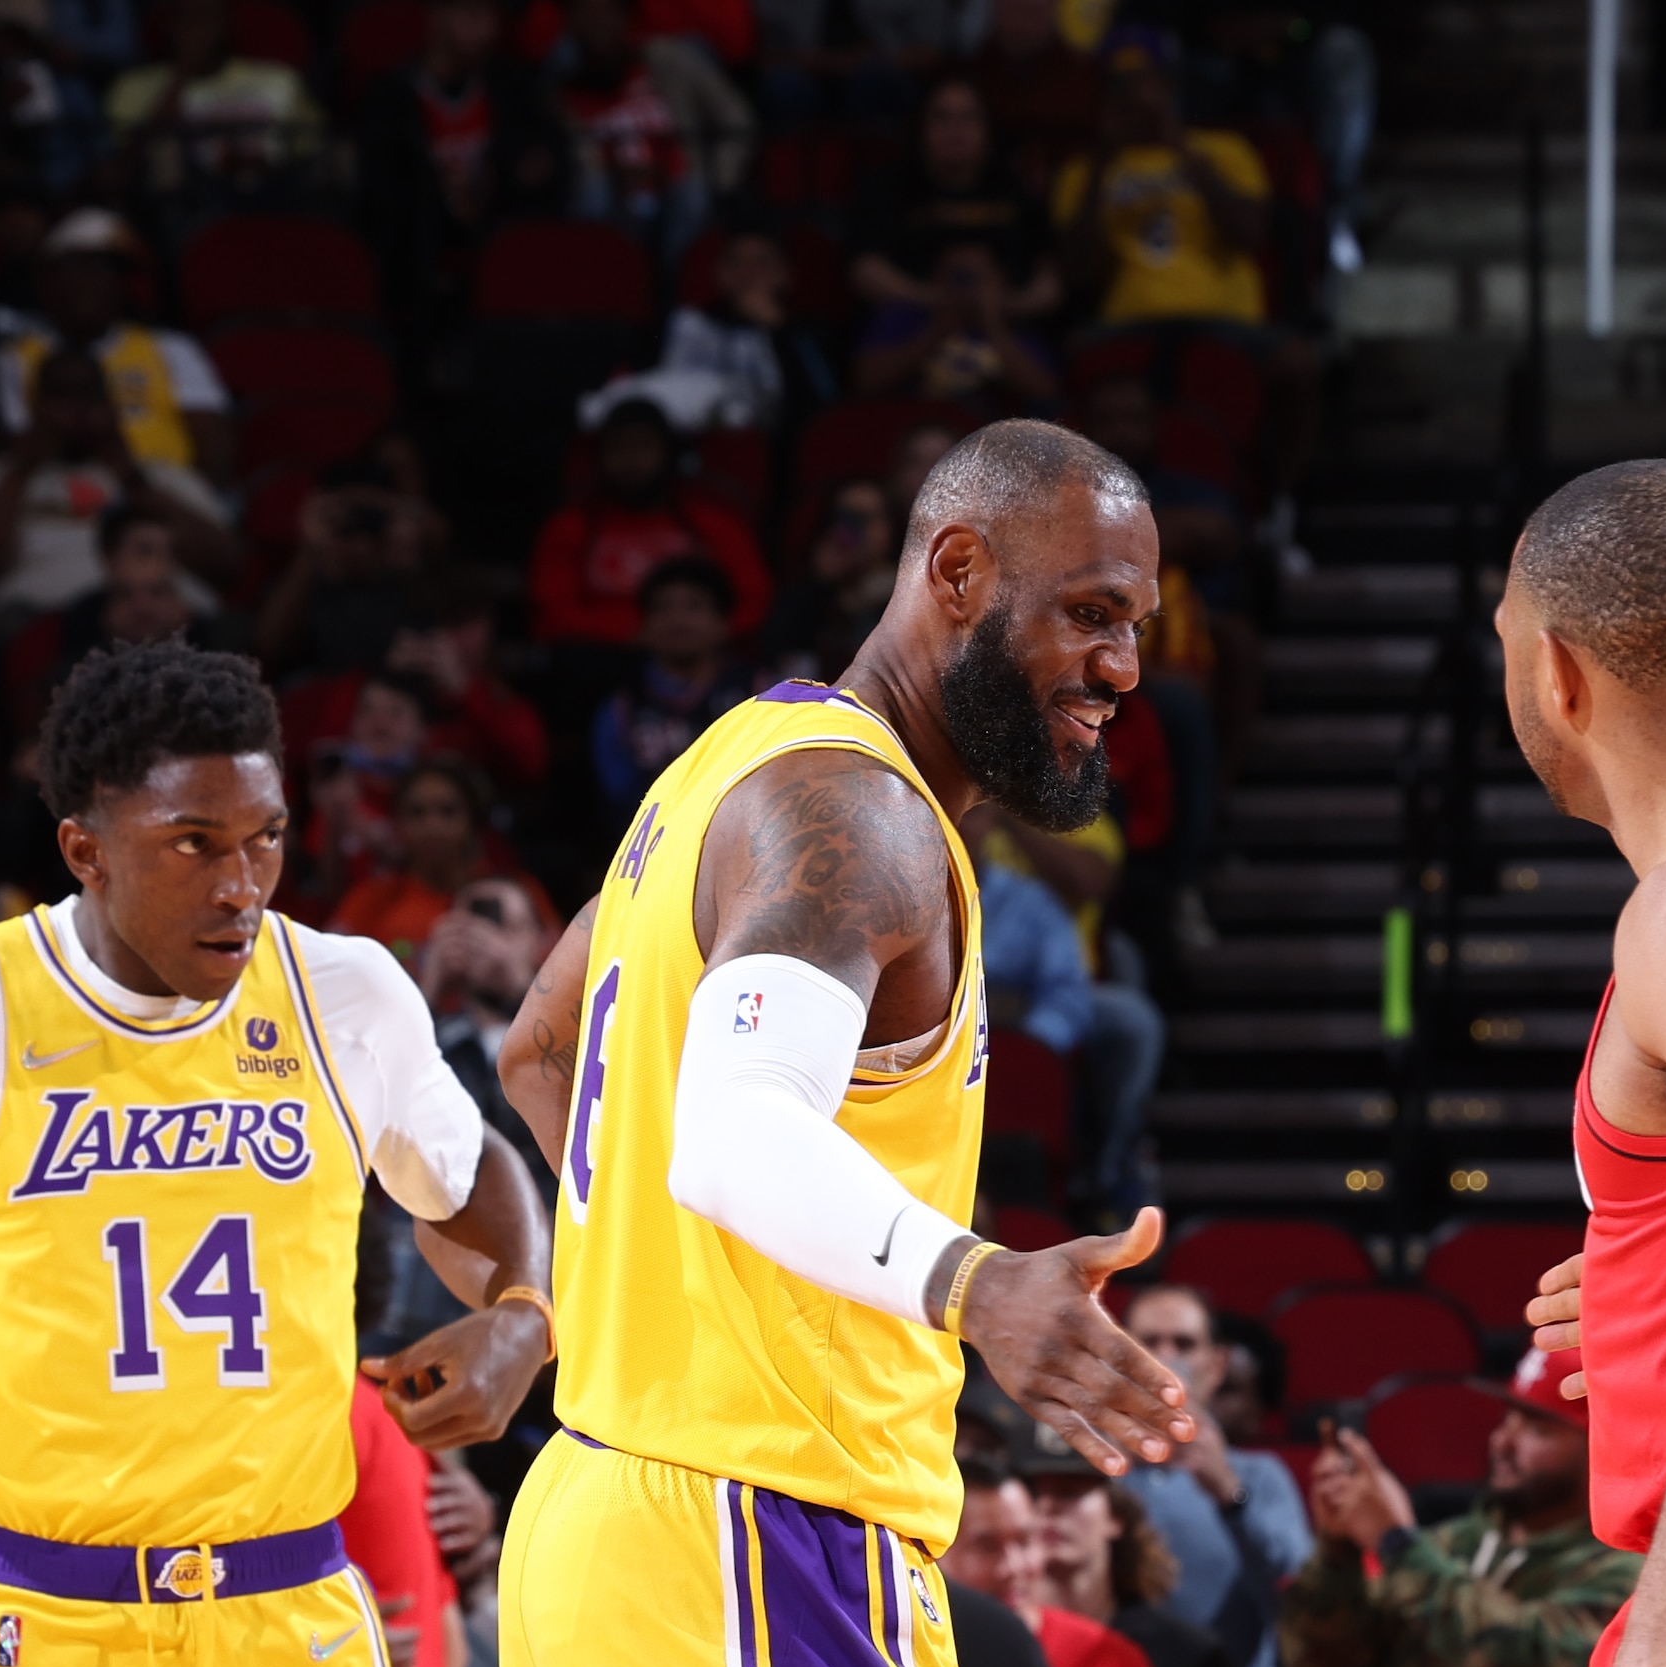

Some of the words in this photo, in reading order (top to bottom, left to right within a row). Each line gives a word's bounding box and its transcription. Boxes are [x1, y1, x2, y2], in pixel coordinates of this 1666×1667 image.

[236, 1055, 300, 1078] bibigo
[9, 1089, 314, 1203] LAKERS
[102, 1213, 270, 1392] 14
[948, 1248, 983, 1309] PROMISE
